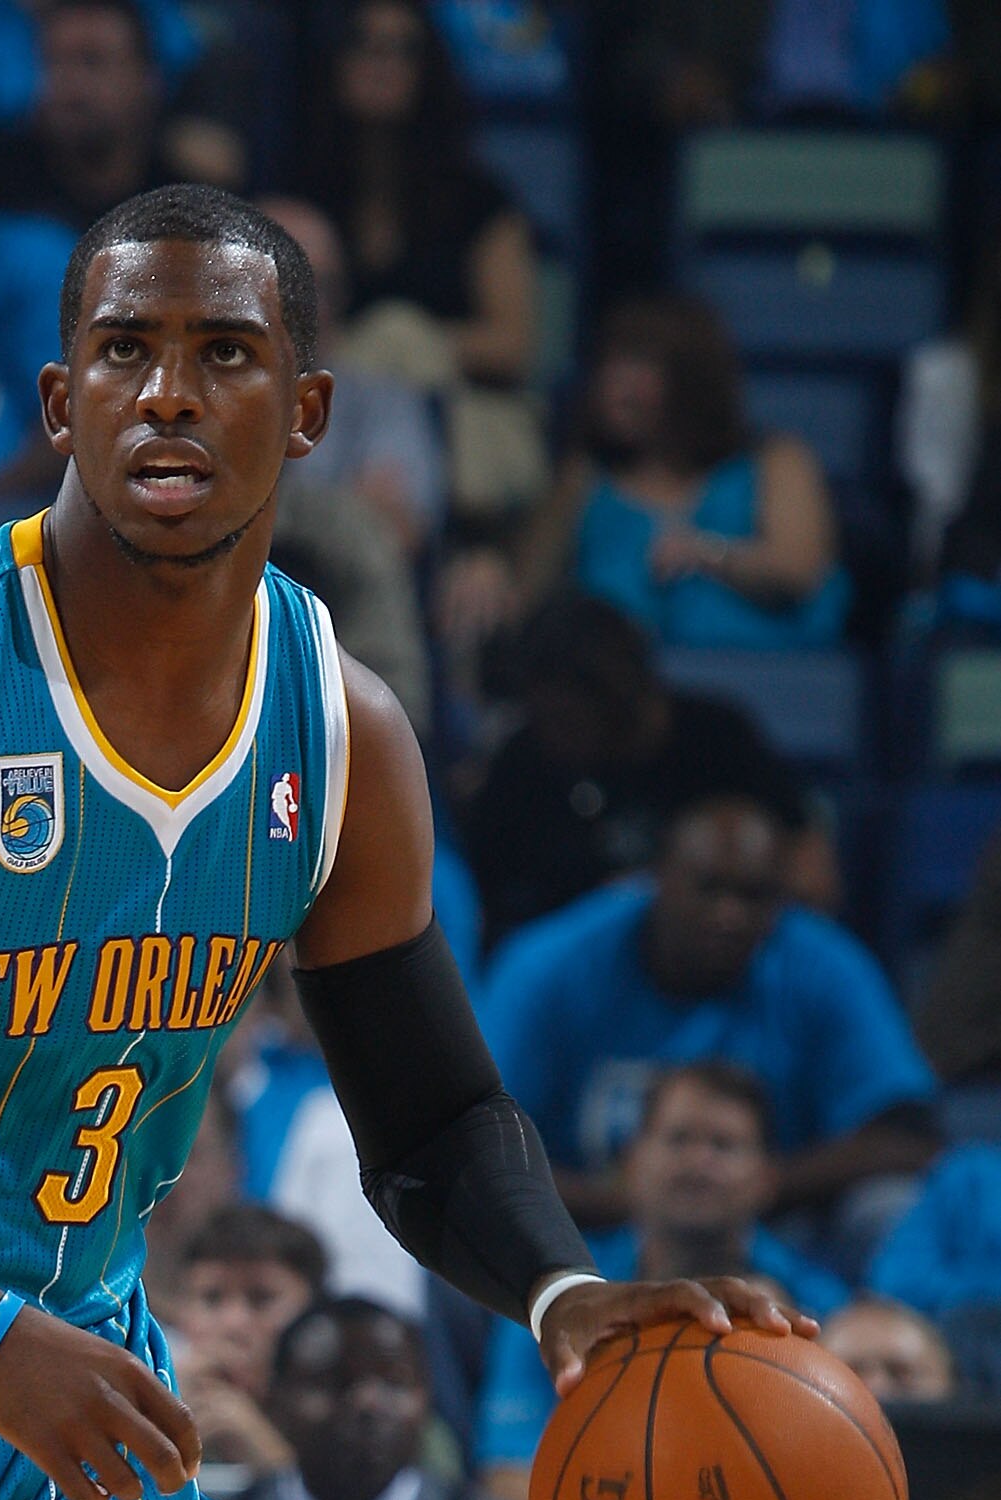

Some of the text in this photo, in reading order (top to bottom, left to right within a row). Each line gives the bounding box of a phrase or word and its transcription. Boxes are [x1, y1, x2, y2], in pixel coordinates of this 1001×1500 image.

[16, 776, 53, 794] BLUE
[269, 827, 289, 839] NBA
[34, 1066, 145, 1225] 3
